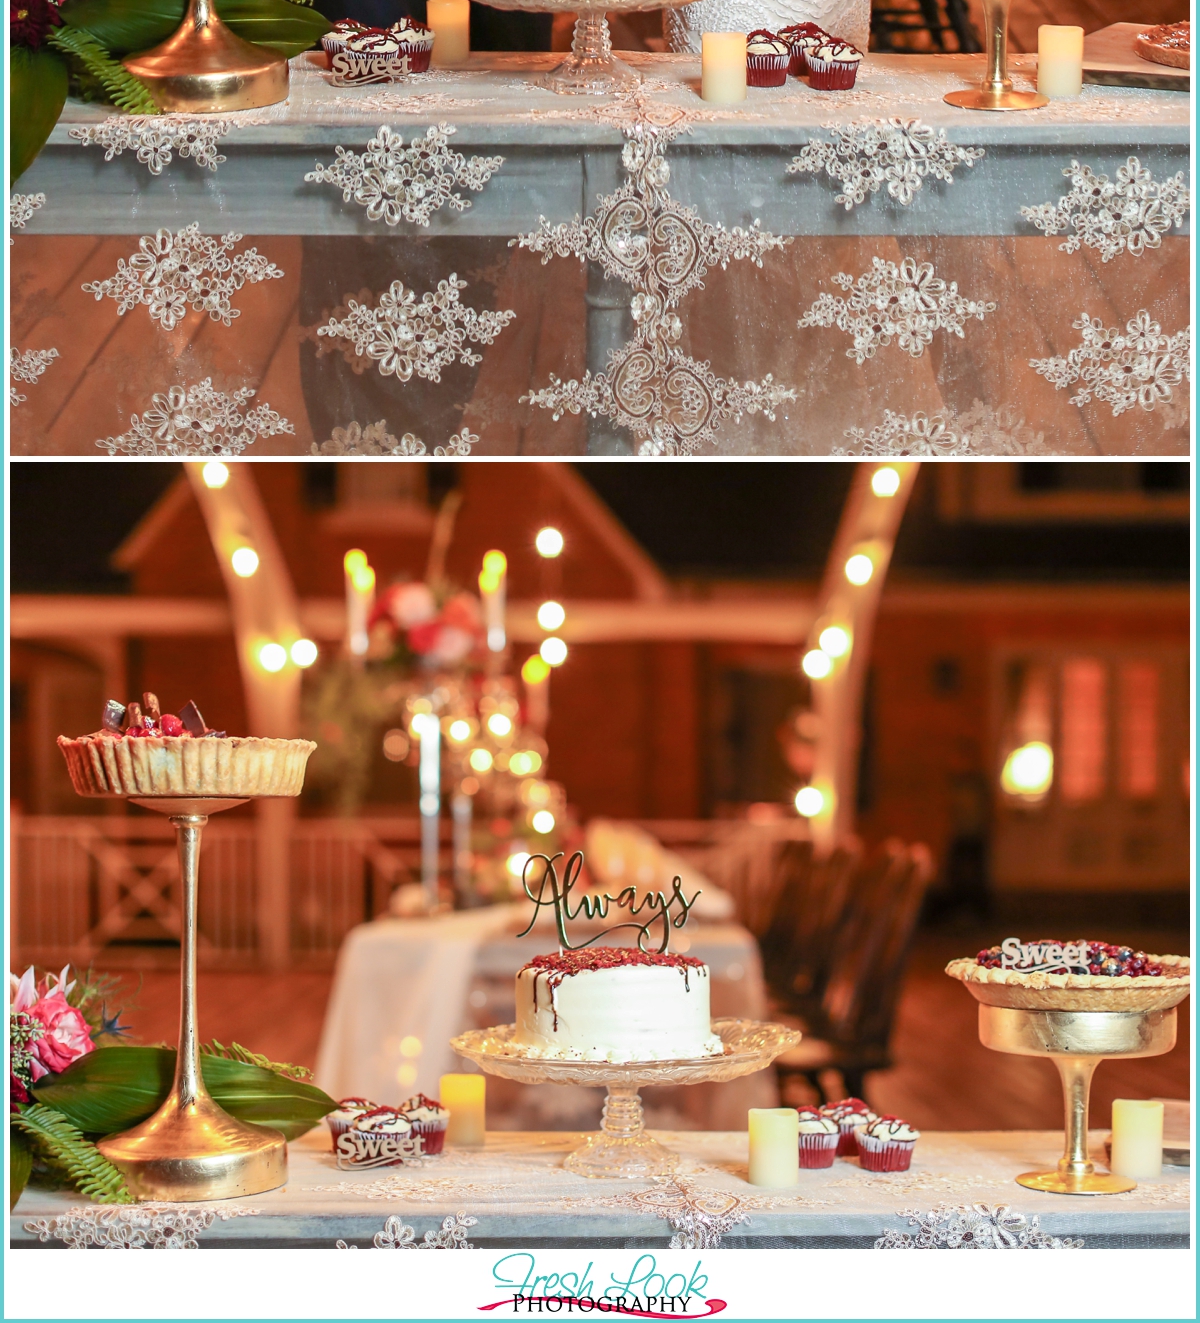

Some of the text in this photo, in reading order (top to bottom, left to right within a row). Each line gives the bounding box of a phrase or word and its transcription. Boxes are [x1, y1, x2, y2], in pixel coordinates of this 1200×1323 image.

[332, 52, 413, 83] Sweet
[516, 850, 704, 955] Always
[1001, 937, 1093, 972] Sweet
[336, 1132, 427, 1166] Sweet
